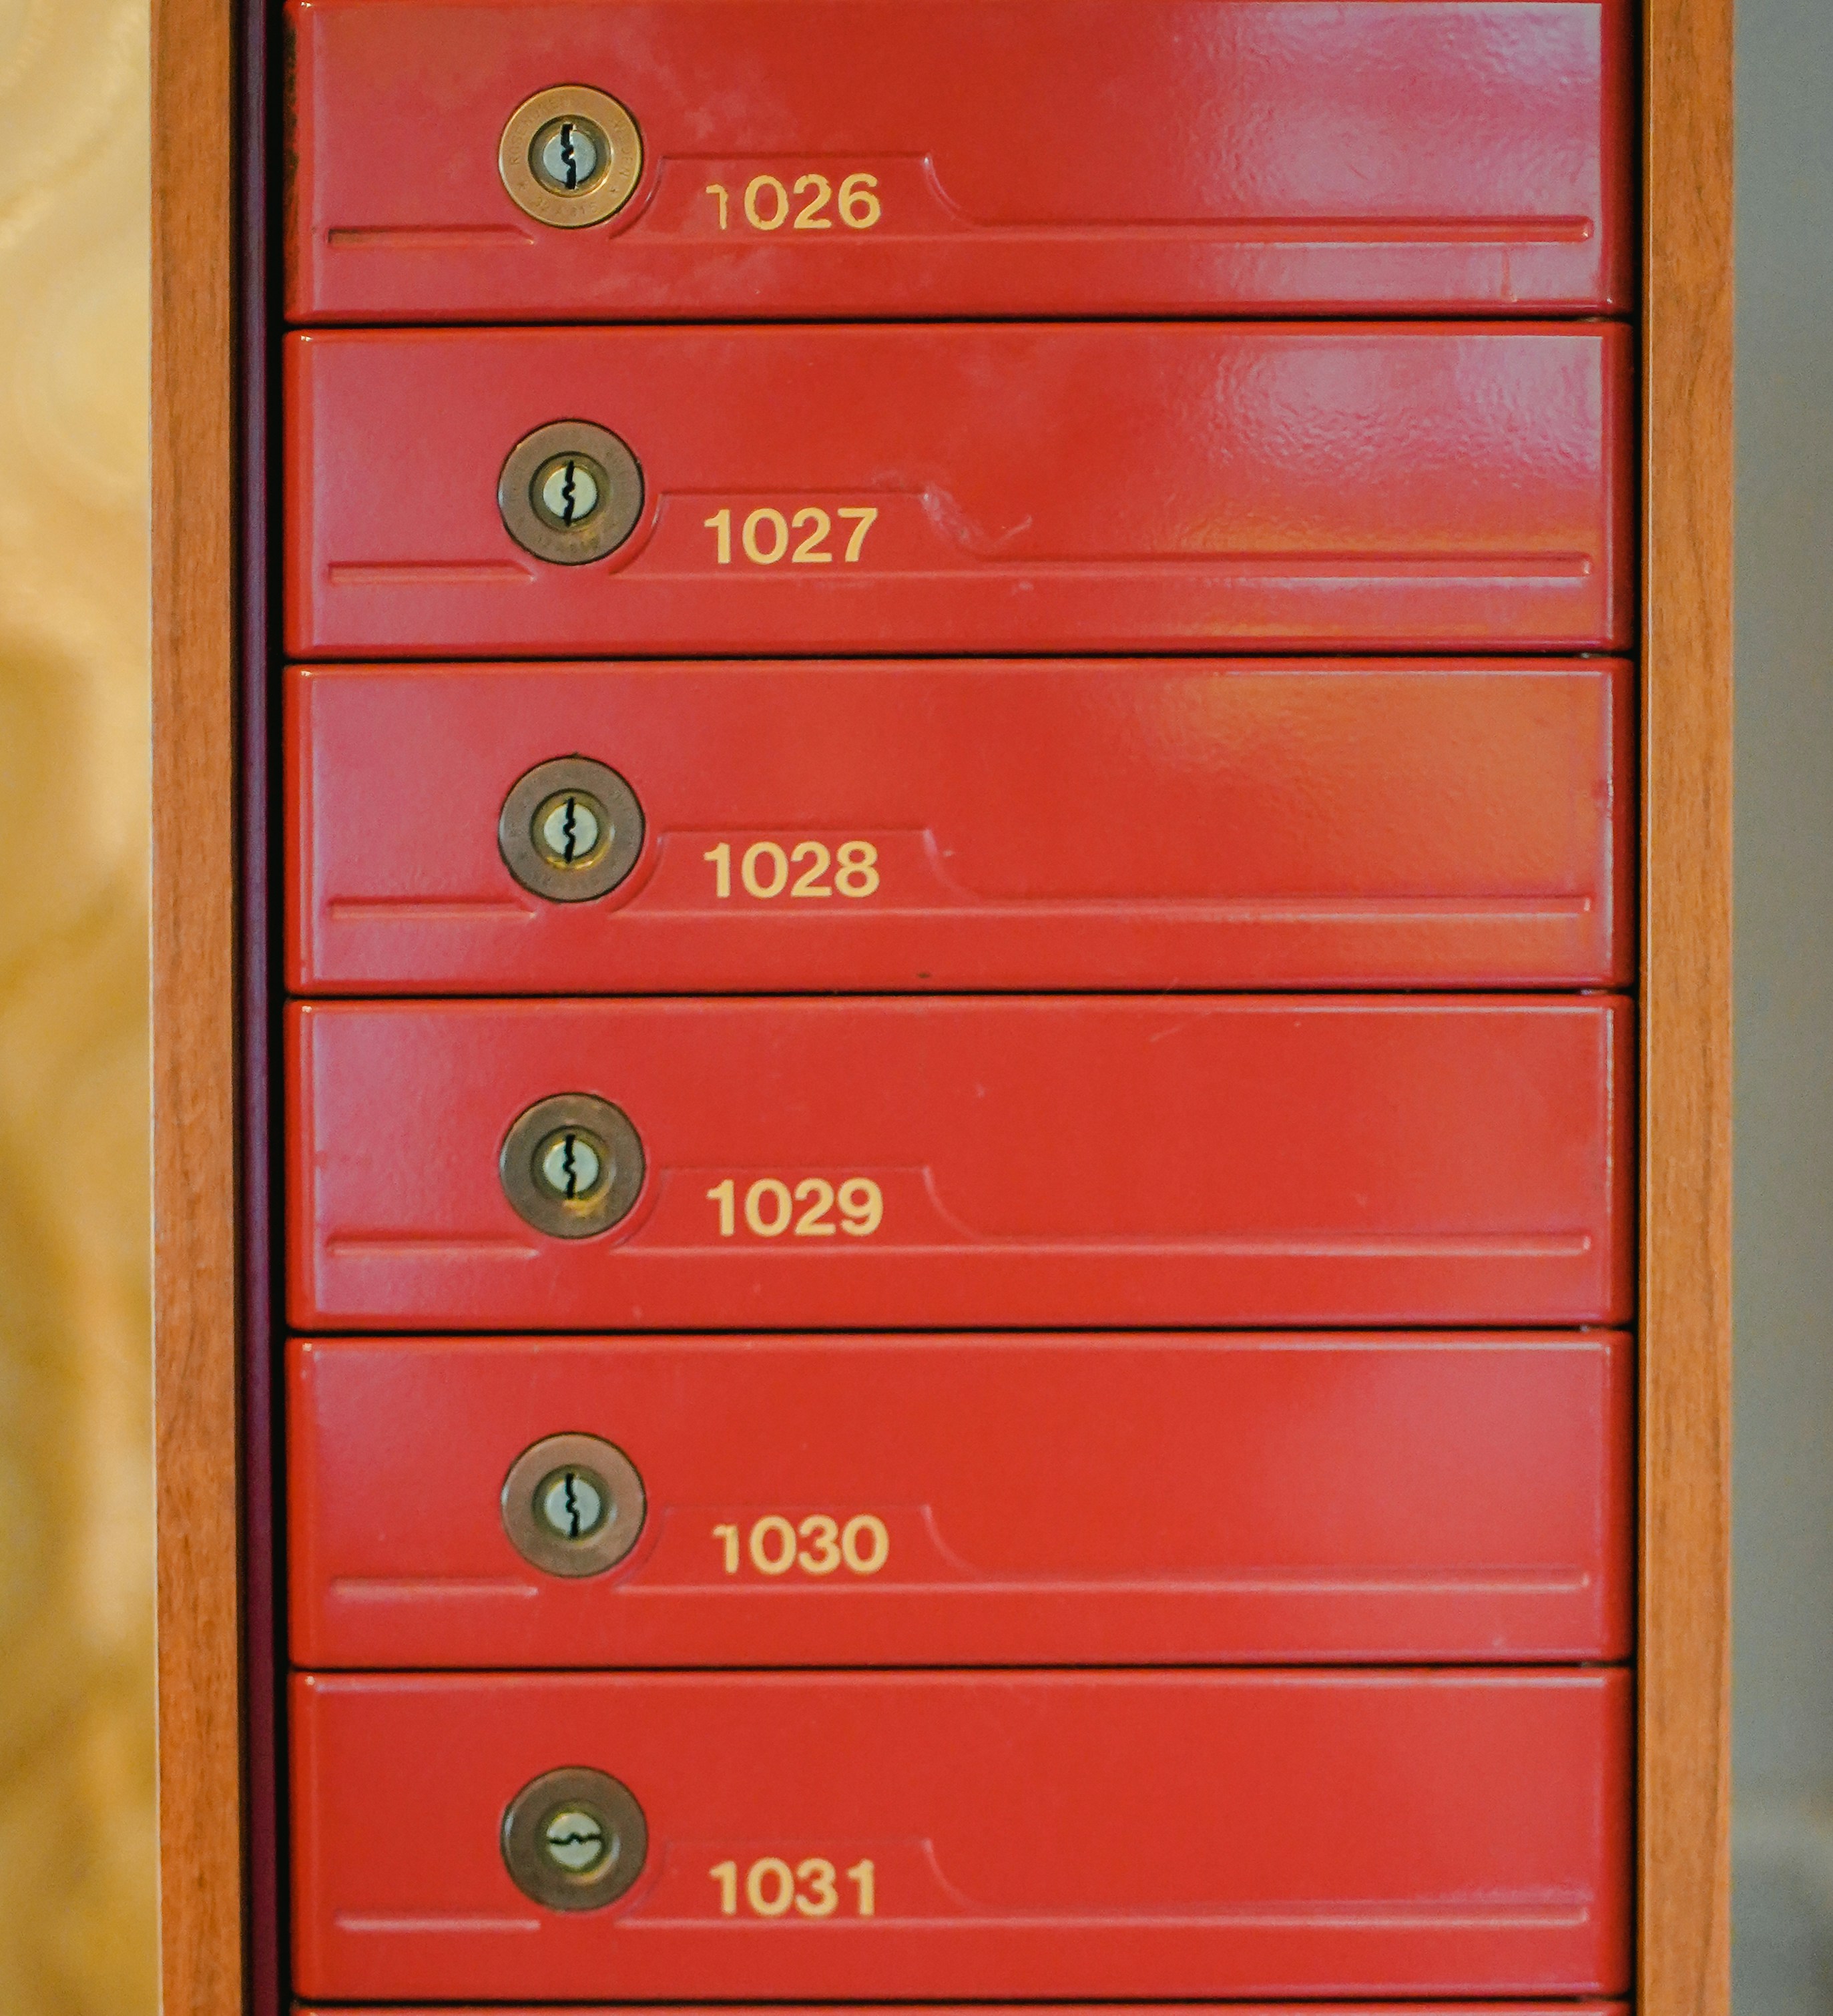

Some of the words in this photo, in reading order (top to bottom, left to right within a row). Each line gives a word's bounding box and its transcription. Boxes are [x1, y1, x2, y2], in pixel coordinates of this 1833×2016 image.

[705, 173, 881, 231] 1026
[704, 507, 878, 565] 1027
[704, 840, 880, 899] 1028
[706, 1178, 883, 1237] 1029
[712, 1515, 889, 1575] 1030
[710, 1857, 874, 1917] 1031
